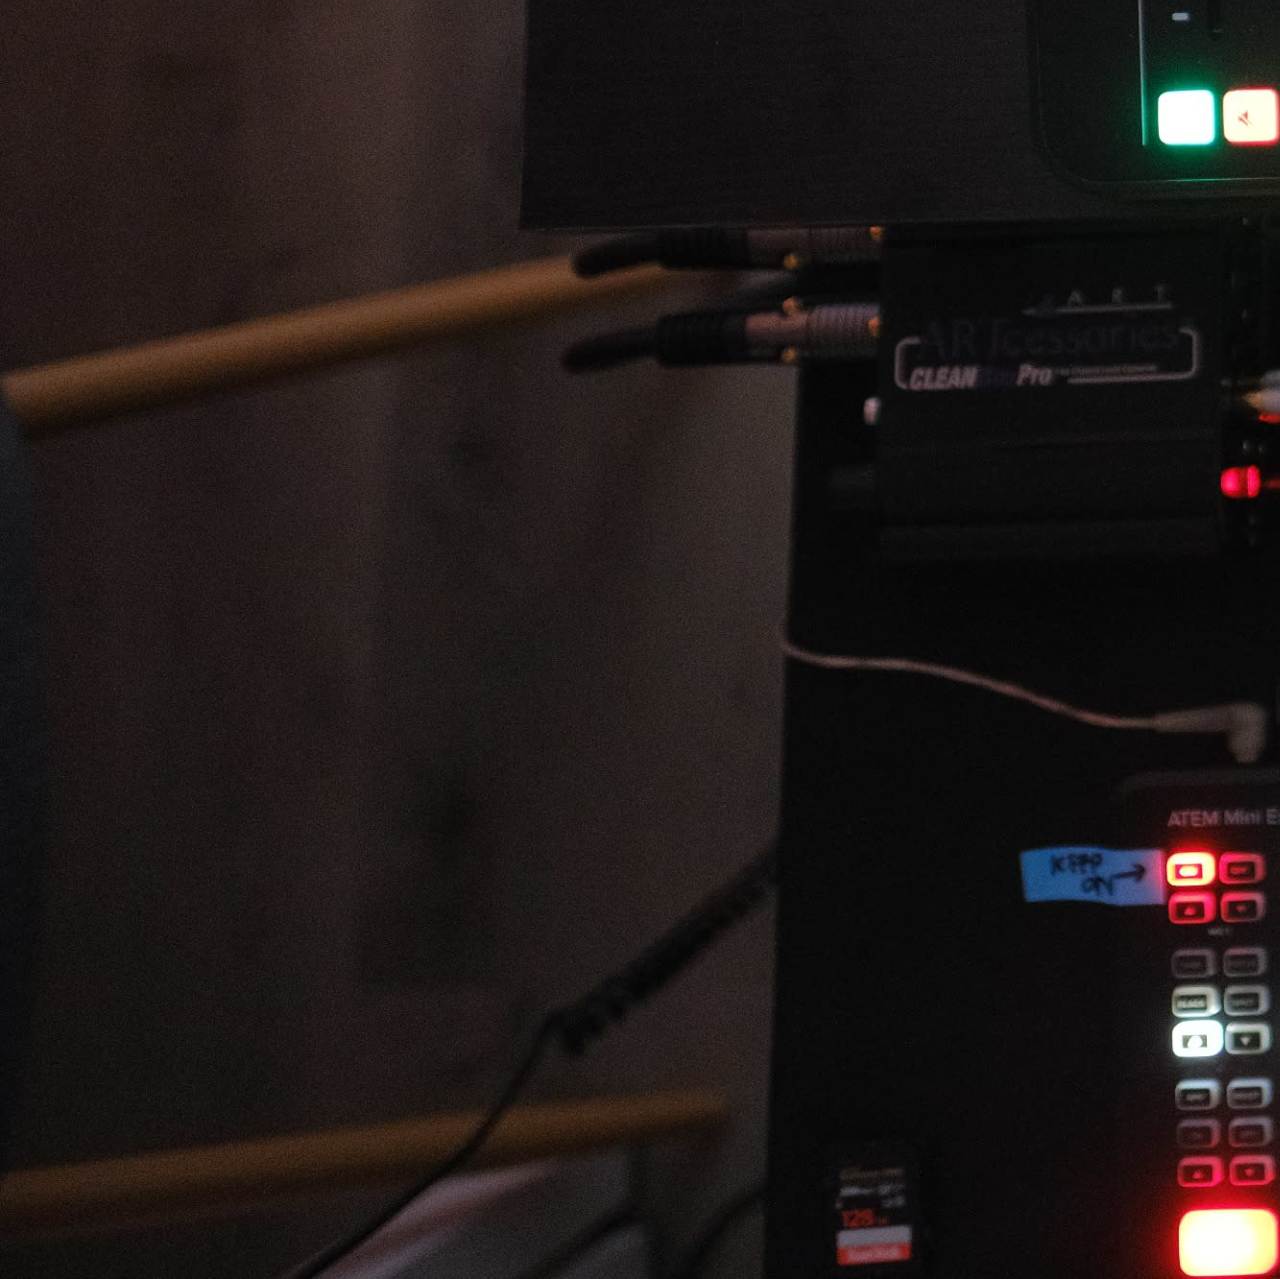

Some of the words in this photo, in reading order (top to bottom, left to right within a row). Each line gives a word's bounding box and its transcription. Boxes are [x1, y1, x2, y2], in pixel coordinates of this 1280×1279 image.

[1016, 363, 1053, 387] Pro
[1167, 808, 1219, 827] ATEM
[1224, 808, 1260, 825] Mini
